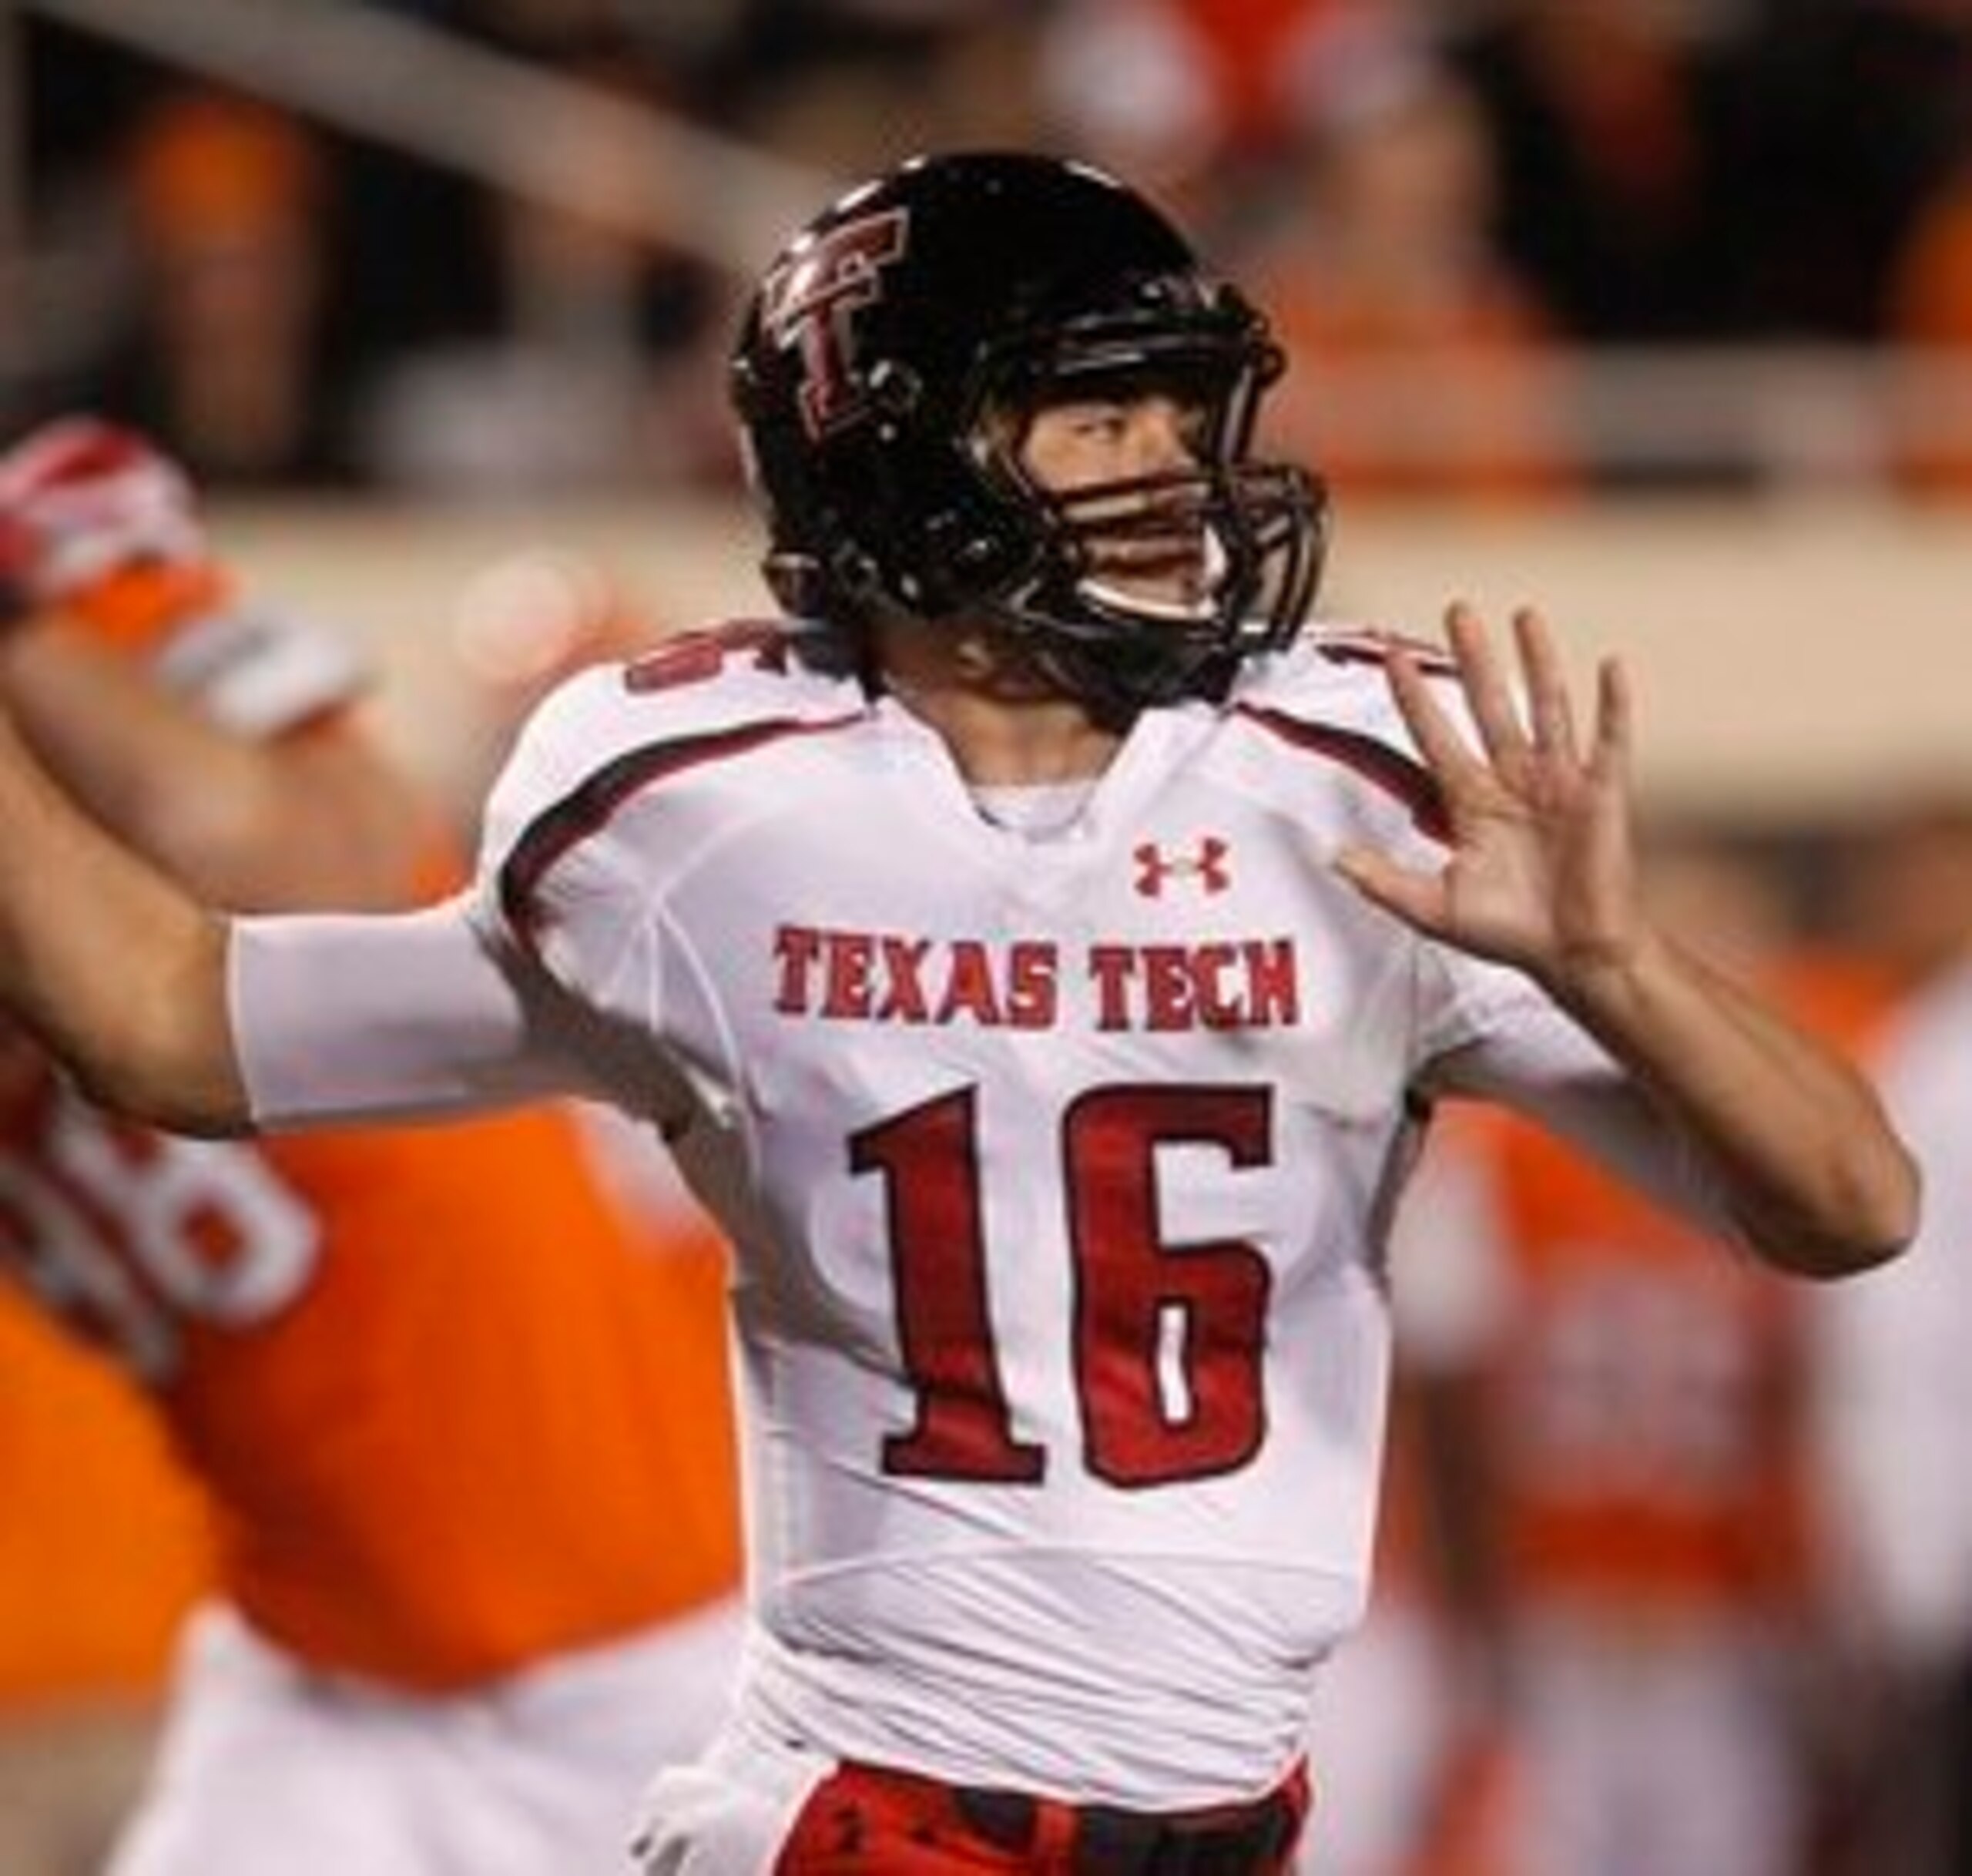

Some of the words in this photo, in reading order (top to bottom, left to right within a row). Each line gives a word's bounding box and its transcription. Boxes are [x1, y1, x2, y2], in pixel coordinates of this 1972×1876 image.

[773, 926, 1058, 1031] TEXAS
[1088, 939, 1299, 1032] TECH
[847, 1082, 1275, 1490] 16
